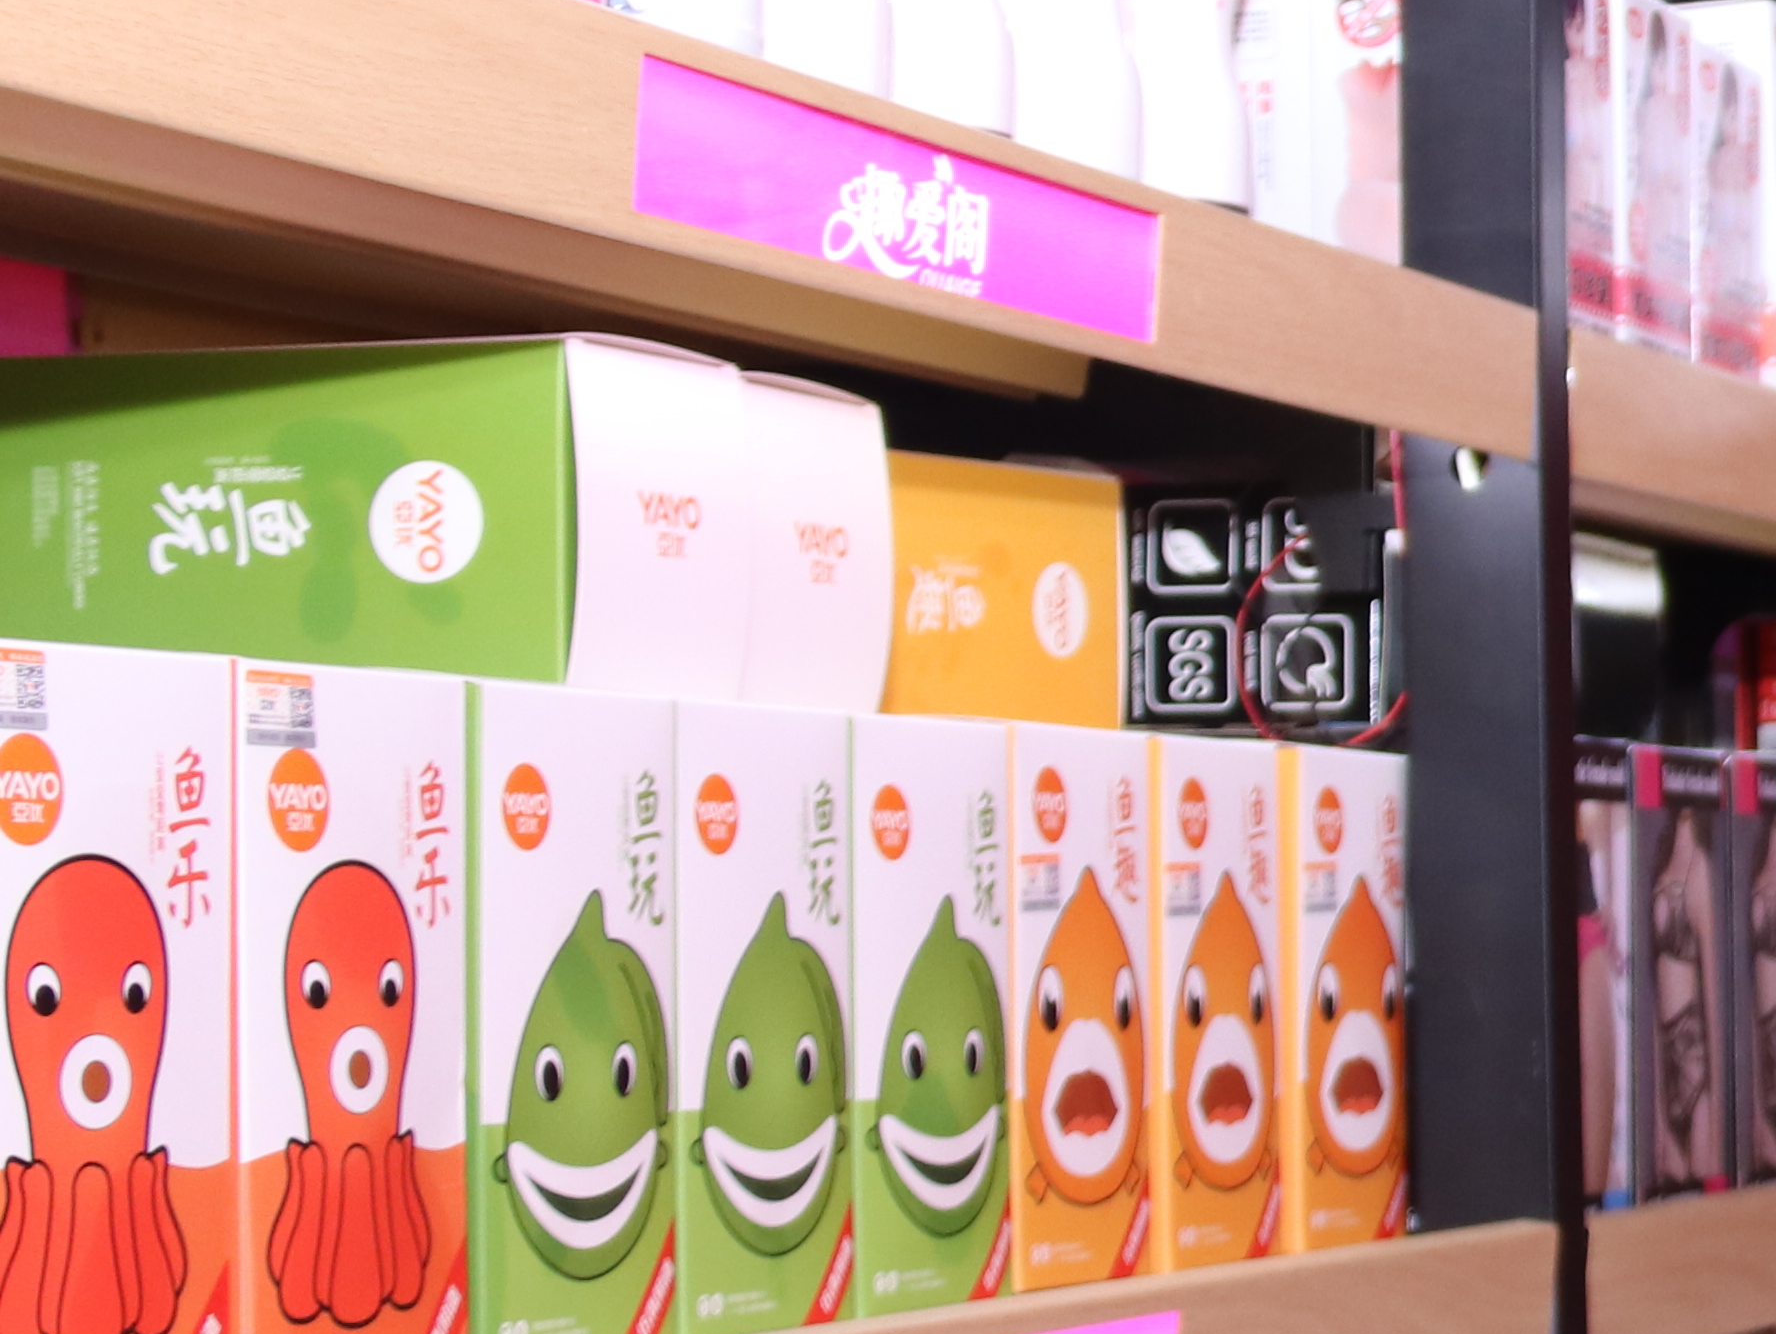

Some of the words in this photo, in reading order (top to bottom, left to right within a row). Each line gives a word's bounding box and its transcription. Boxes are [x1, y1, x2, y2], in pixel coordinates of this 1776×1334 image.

[822, 154, 991, 280] 趣爱阁
[417, 468, 447, 574] YAYO
[637, 490, 701, 531] YAYO
[793, 520, 850, 560] YAYO
[1167, 628, 1215, 702] SGS
[0, 770, 61, 800] YAYO
[268, 782, 329, 811] YAYO
[502, 791, 549, 817] YAYO
[698, 800, 737, 824] YAYO
[167, 745, 212, 929] 鱼乐
[414, 759, 450, 929] 鱼乐
